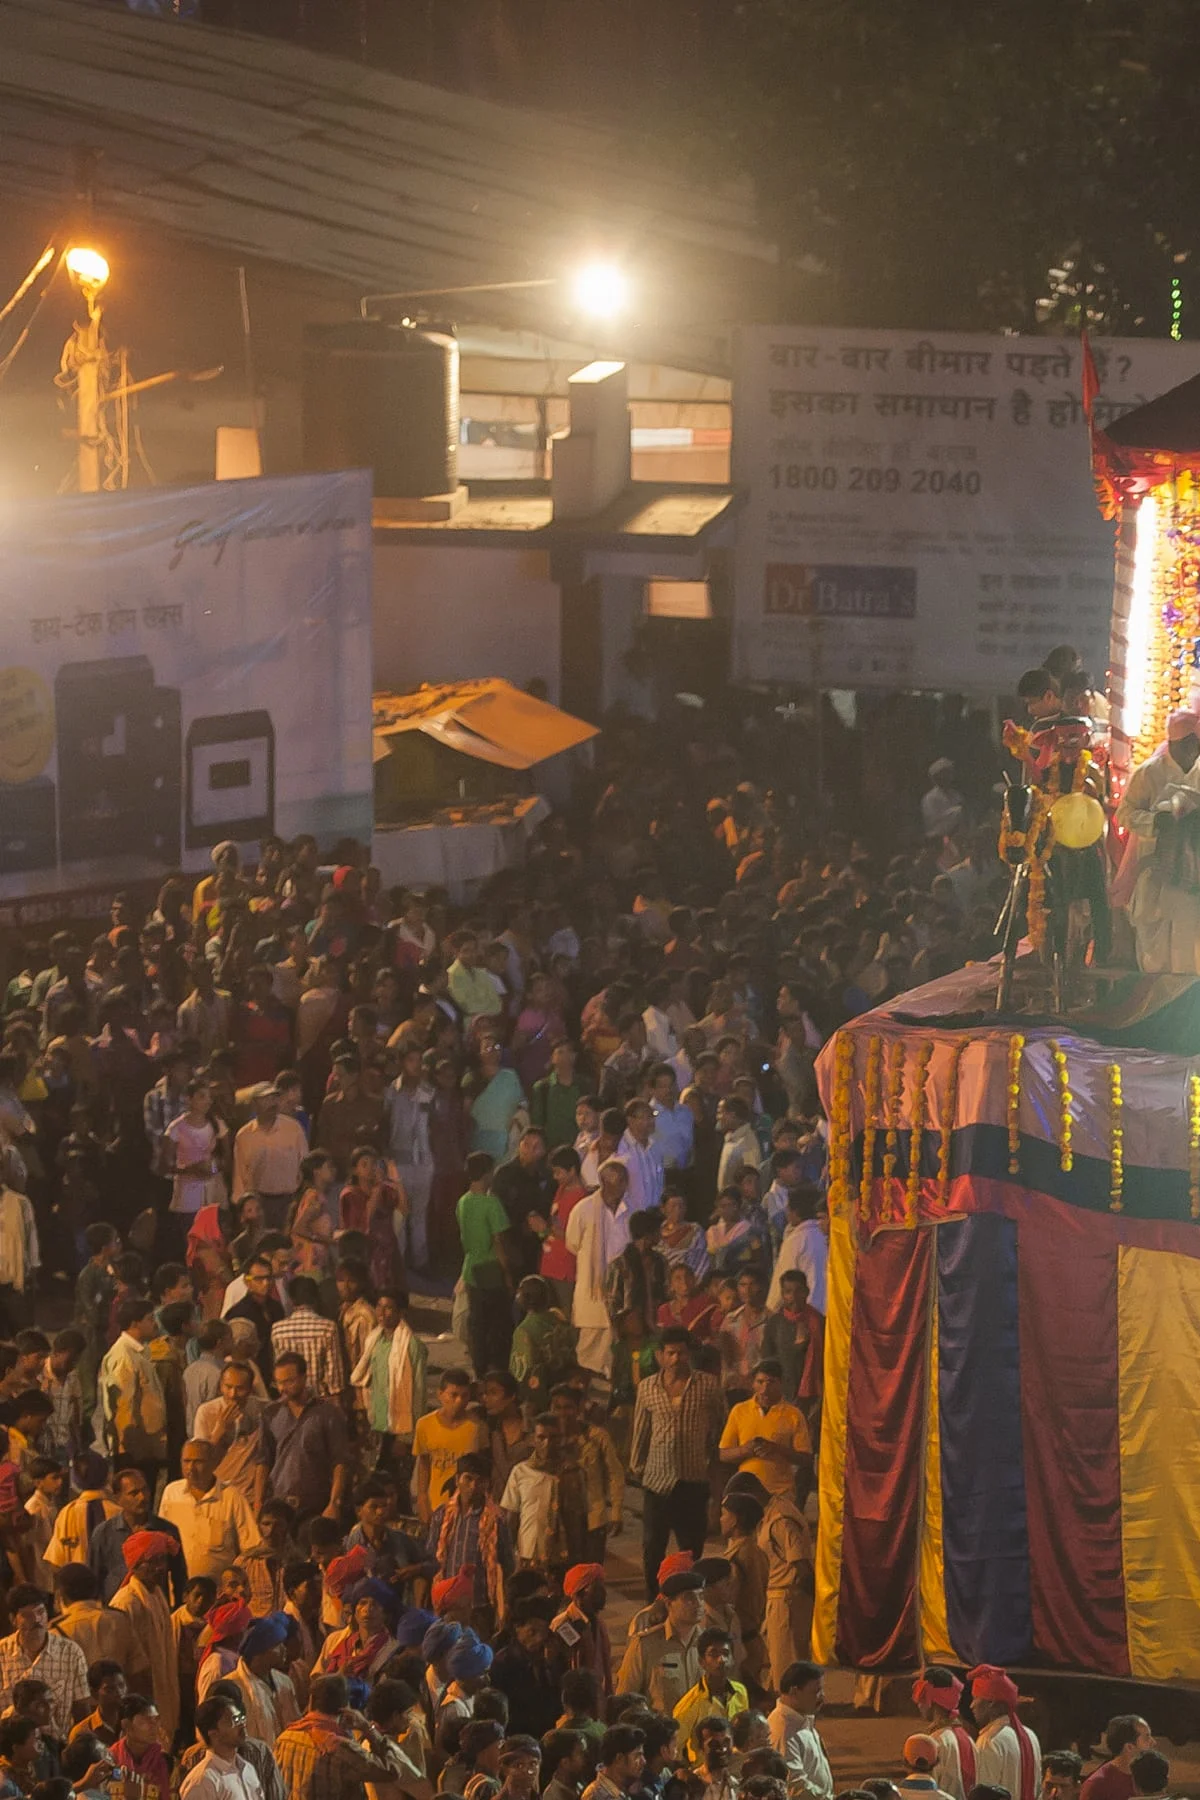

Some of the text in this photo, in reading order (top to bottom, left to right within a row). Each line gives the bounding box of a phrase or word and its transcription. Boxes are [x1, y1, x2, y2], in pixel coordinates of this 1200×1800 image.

[768, 463, 982, 496] 1800 209 2040
